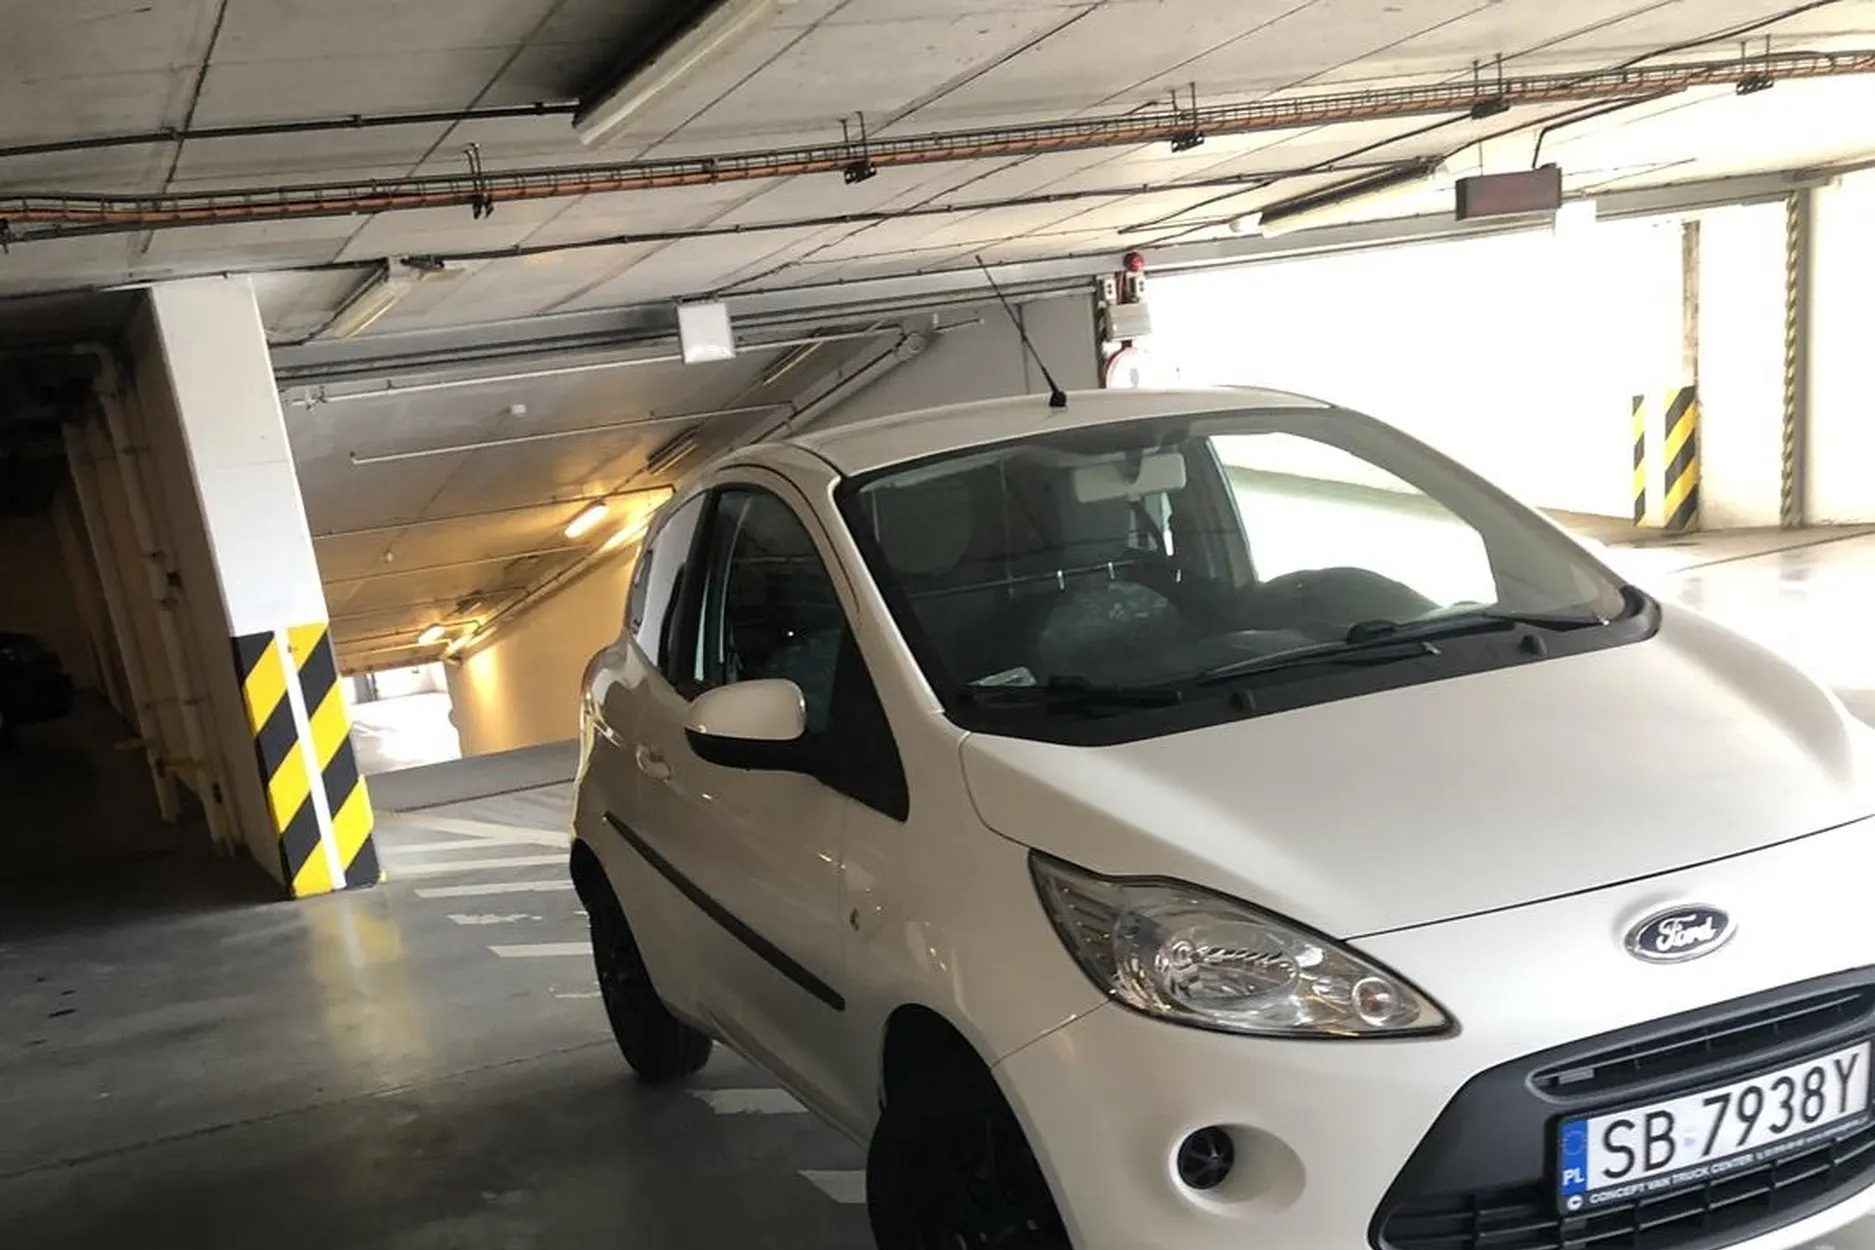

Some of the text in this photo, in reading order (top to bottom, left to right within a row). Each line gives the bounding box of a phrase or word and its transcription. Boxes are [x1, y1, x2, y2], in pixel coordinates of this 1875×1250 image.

[1656, 914, 1717, 951] Ford
[1603, 1053, 1859, 1178] SB 7938Y
[1563, 1167, 1584, 1186] PL
[1590, 1183, 1645, 1203] CONCEPT
